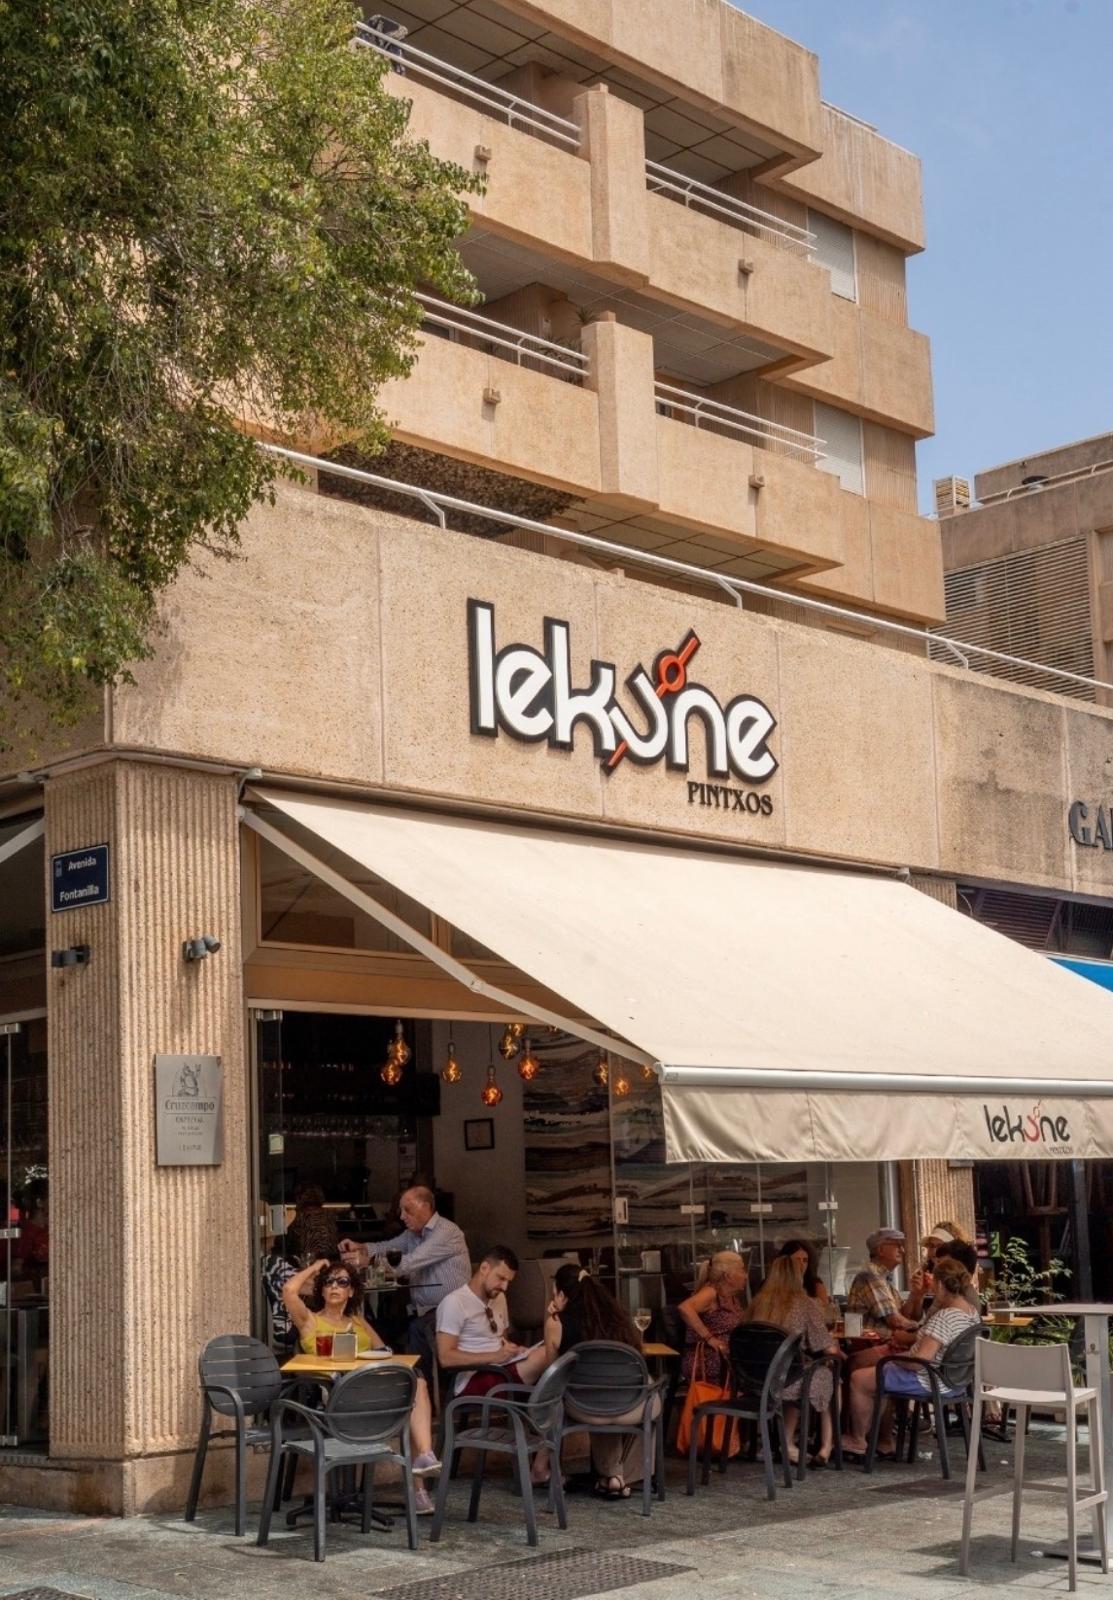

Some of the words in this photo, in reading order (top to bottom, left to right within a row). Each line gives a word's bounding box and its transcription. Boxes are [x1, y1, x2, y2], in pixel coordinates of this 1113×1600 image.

[687, 780, 774, 816] PINTXOS
[1068, 800, 1113, 851] GA
[68, 856, 97, 871] Avenida
[60, 884, 100, 902] Fontanilla
[165, 1099, 215, 1112] Cruzcampo
